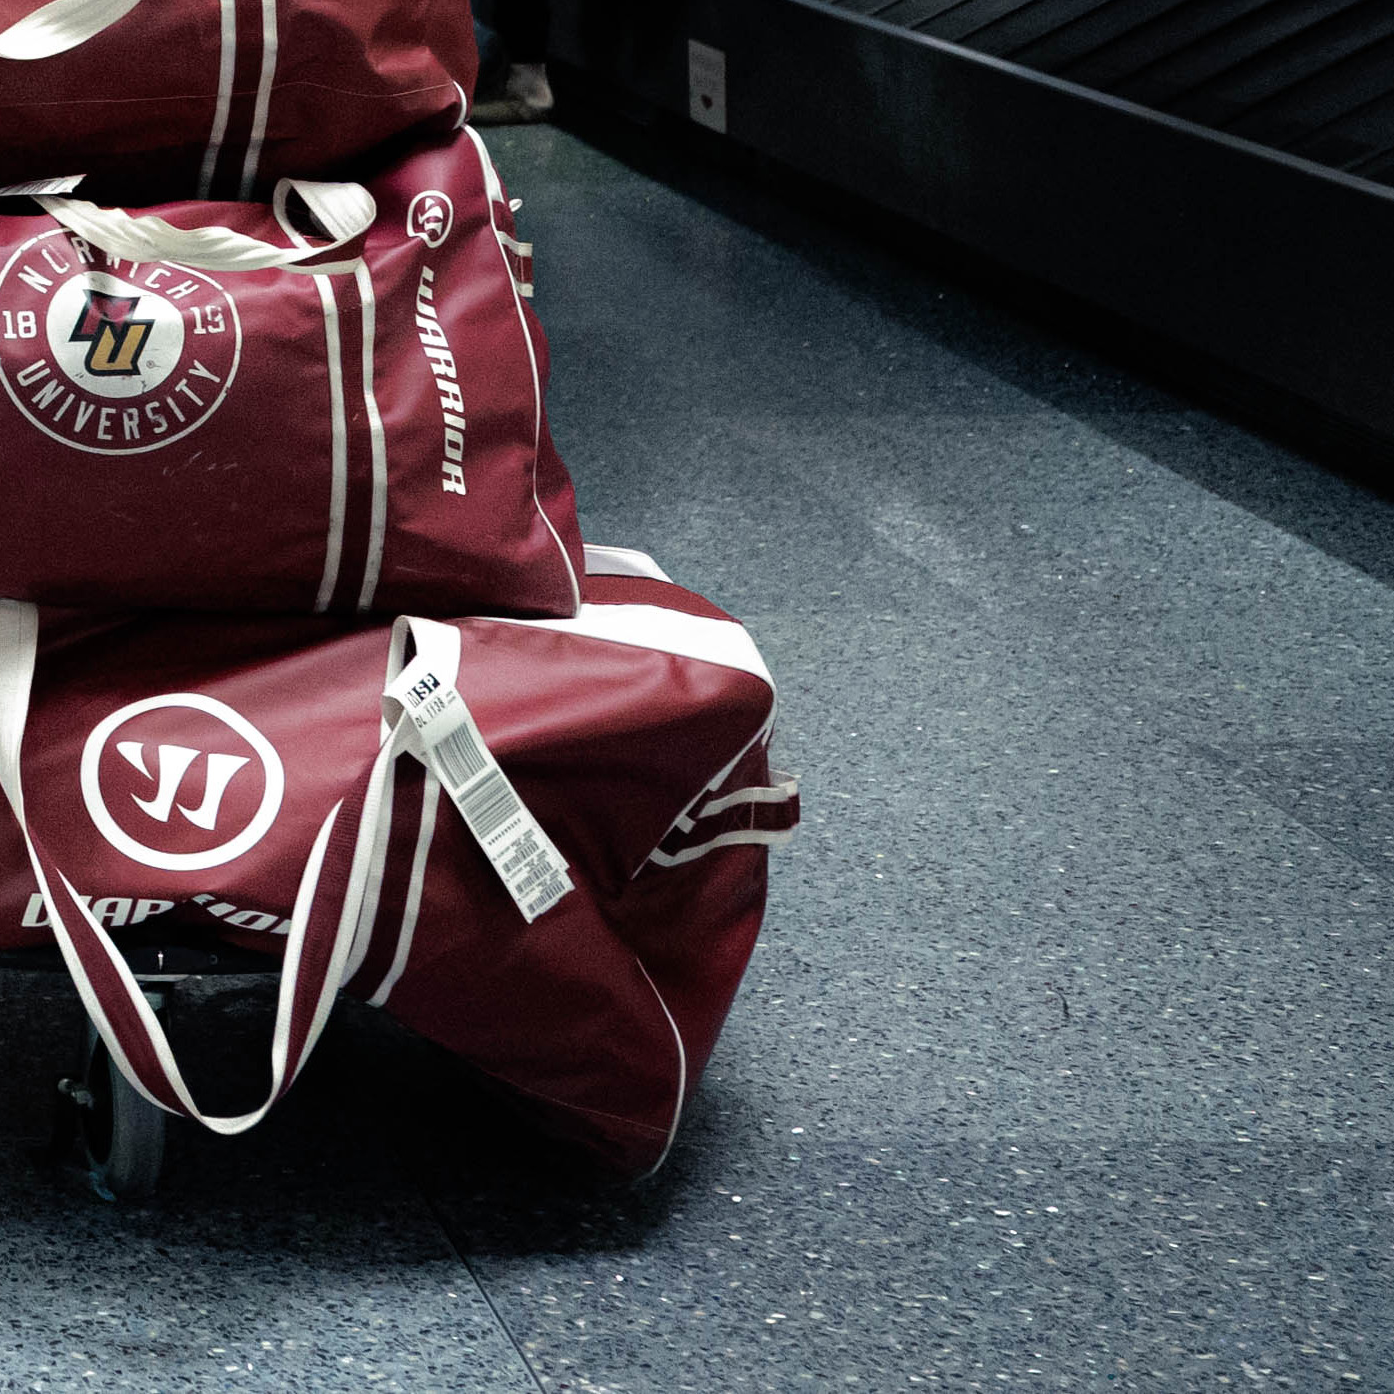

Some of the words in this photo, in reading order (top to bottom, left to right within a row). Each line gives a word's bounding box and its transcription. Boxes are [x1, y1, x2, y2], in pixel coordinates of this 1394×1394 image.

[2, 310, 37, 340] 18
[16, 359, 221, 441] UNIVERSITY
[415, 265, 466, 496] WARRIOR
